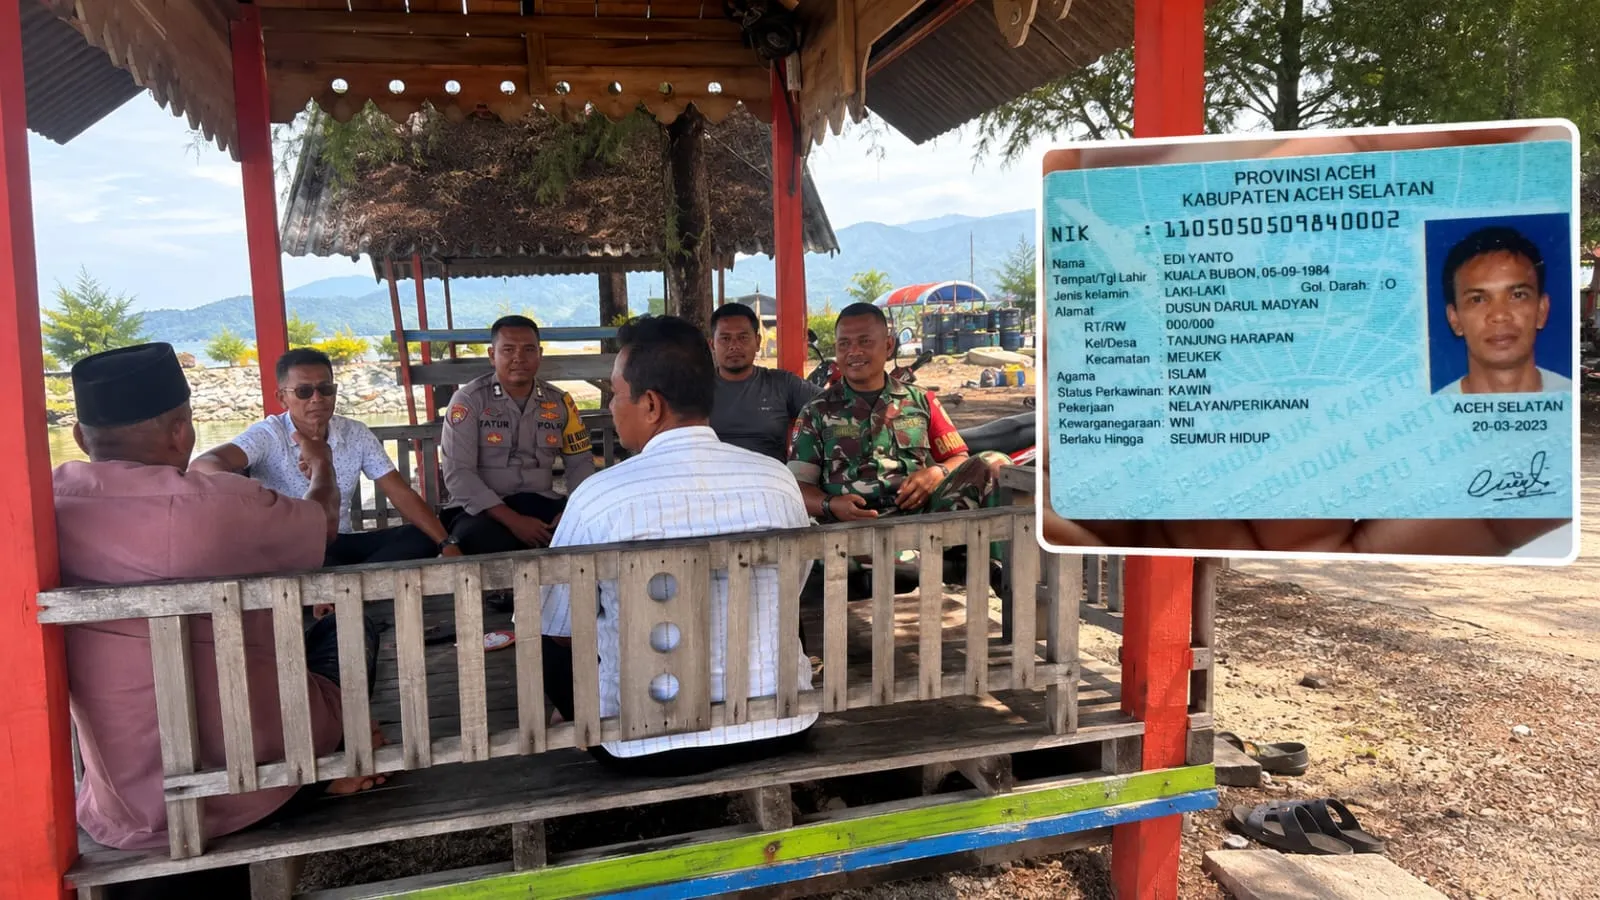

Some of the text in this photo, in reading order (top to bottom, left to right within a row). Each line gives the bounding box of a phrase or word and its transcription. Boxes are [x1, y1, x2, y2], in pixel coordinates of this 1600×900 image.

[1235, 164, 1375, 185] PROVINSI ACEH
[1183, 180, 1434, 207] KABUPATEN ACEH SELATAN
[1050, 224, 1089, 242] NIK
[1165, 211, 1399, 238] 1105050509840002
[1052, 252, 1233, 269] Nama EDI YANTO
[1053, 273, 1116, 286] Tempat/Tgl
[1119, 272, 1146, 282] Lahir
[1164, 270, 1206, 281] KUALA
[1262, 265, 1329, 278] 05-09-1984
[1054, 291, 1082, 301] Jenis
[1085, 289, 1129, 299] kelamin
[1165, 285, 1225, 297] LAKI-LAKI
[1055, 298, 1318, 317] Alamat DUSUN DARUL MADYAN
[1085, 319, 1214, 332] RT/RW 000/000
[1085, 333, 1294, 348] Kel/Desa TANJUNG HARAPAN
[1086, 351, 1221, 365] Kecamatan MEUKEK
[1057, 368, 1206, 384] Agama ISLAM
[1058, 387, 1092, 397] Status
[1169, 385, 1211, 395] KAWIN
[1059, 399, 1309, 415] Pekerjaan NELAYAN/PERIKANAN
[1453, 400, 1563, 413] ACEH SELATAN
[1170, 417, 1194, 427] WNI
[1473, 420, 1547, 432] 20-03-2023
[1060, 433, 1270, 446] Berlaku Hingga SEUMUR HIDUP
